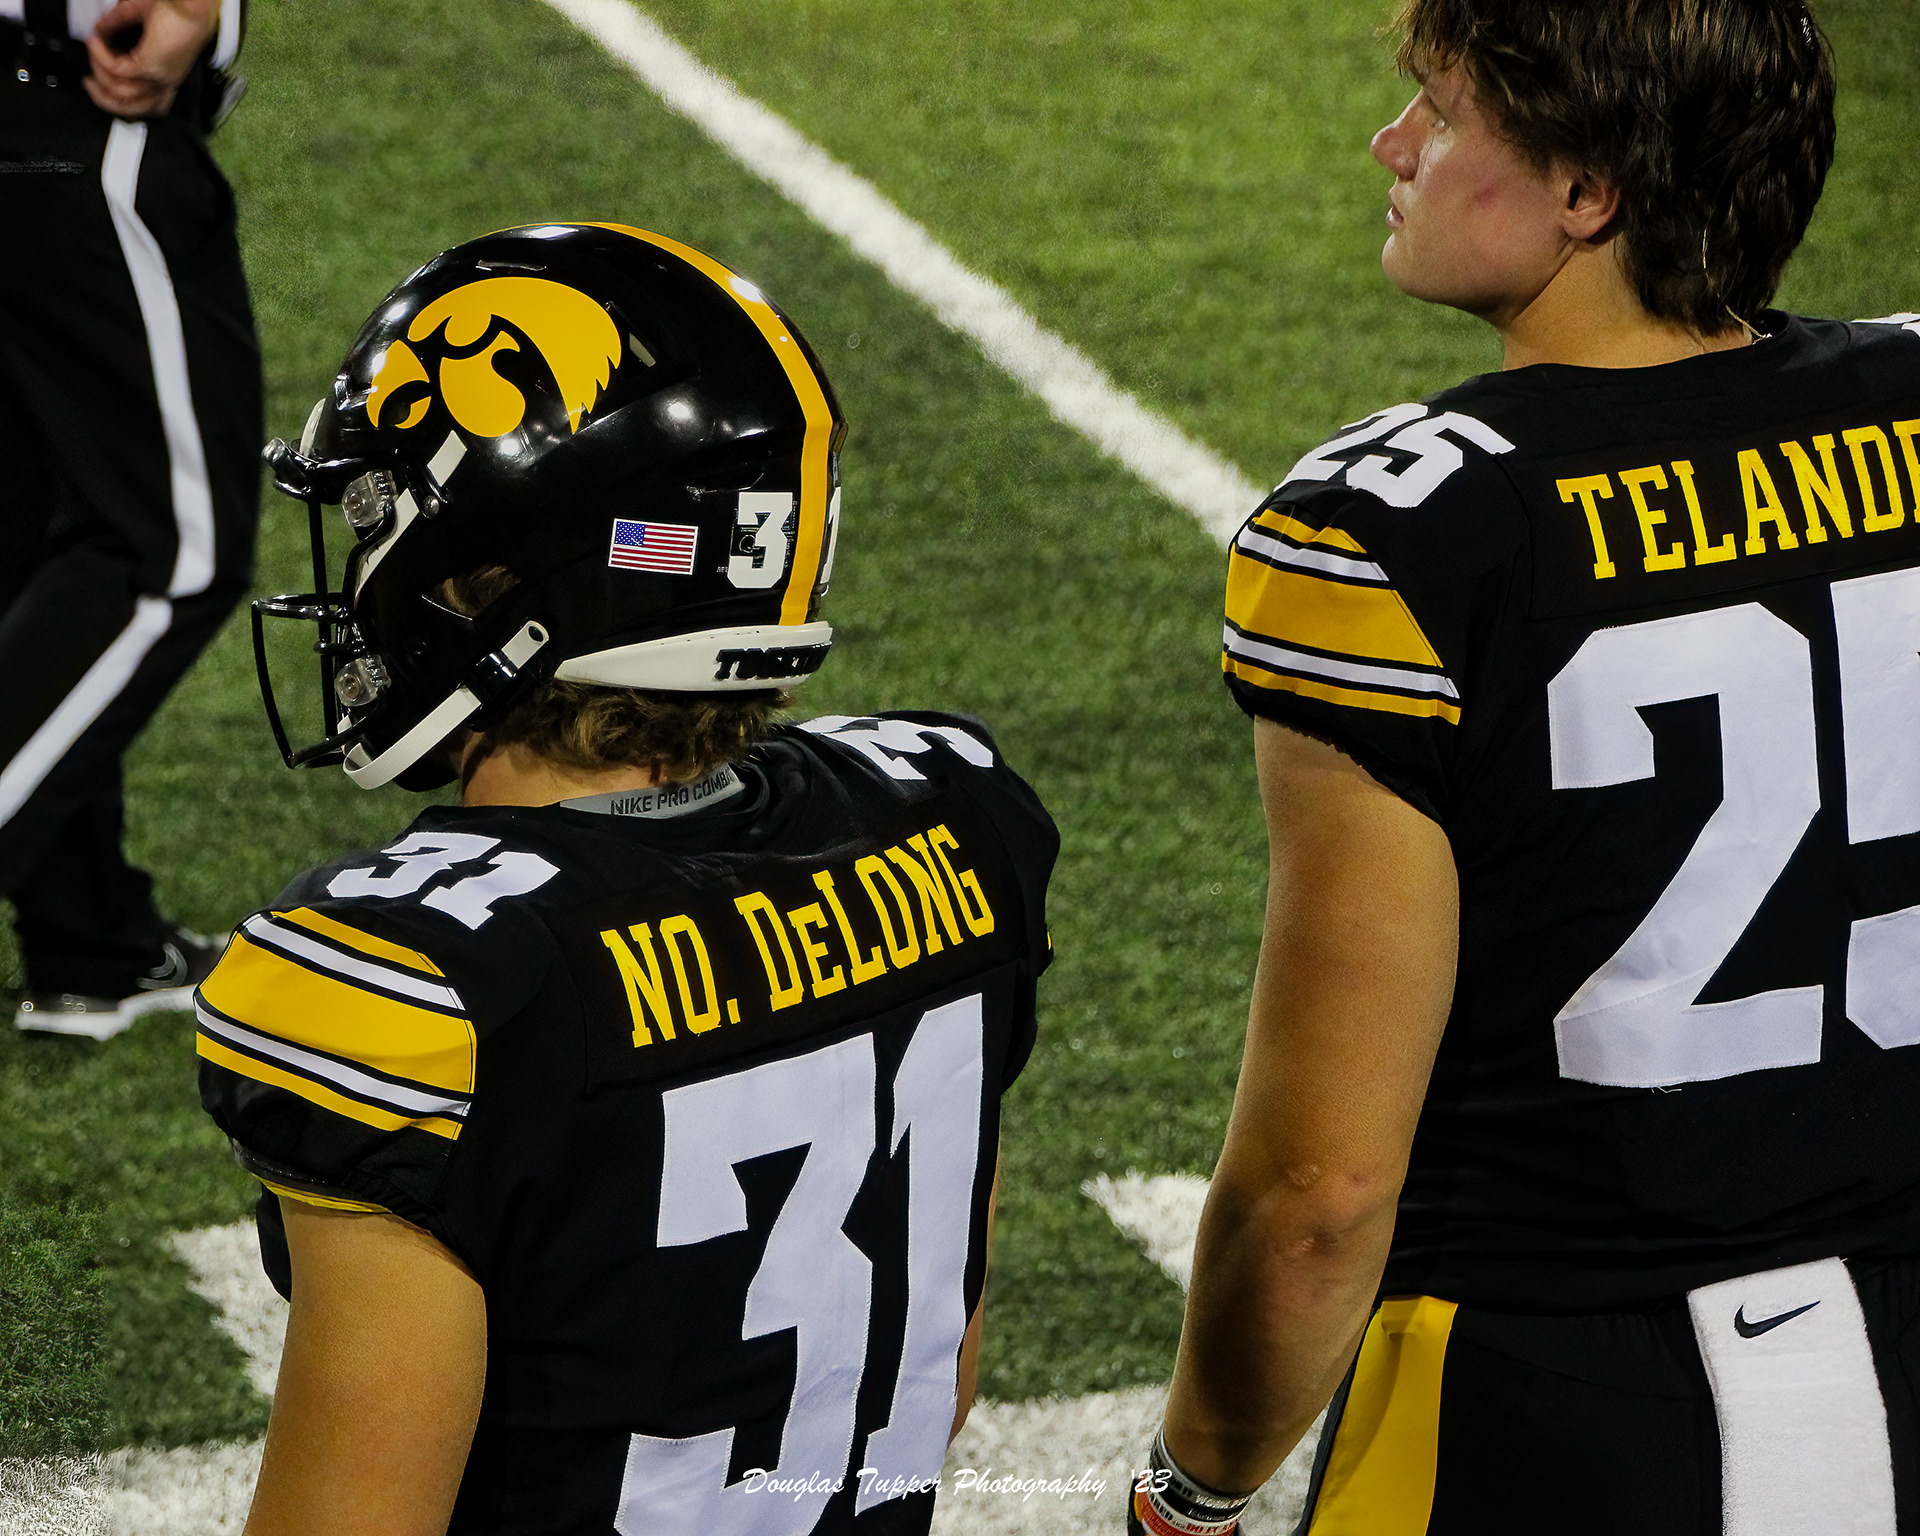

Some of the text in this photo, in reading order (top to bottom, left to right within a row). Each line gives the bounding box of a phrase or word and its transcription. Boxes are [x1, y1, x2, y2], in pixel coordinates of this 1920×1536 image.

[1274, 402, 1517, 508] 25
[610, 795, 652, 816] NIKE
[656, 786, 689, 810] PRO
[326, 831, 561, 931] 31
[599, 914, 742, 1049] NO.
[613, 992, 983, 1536] 31
